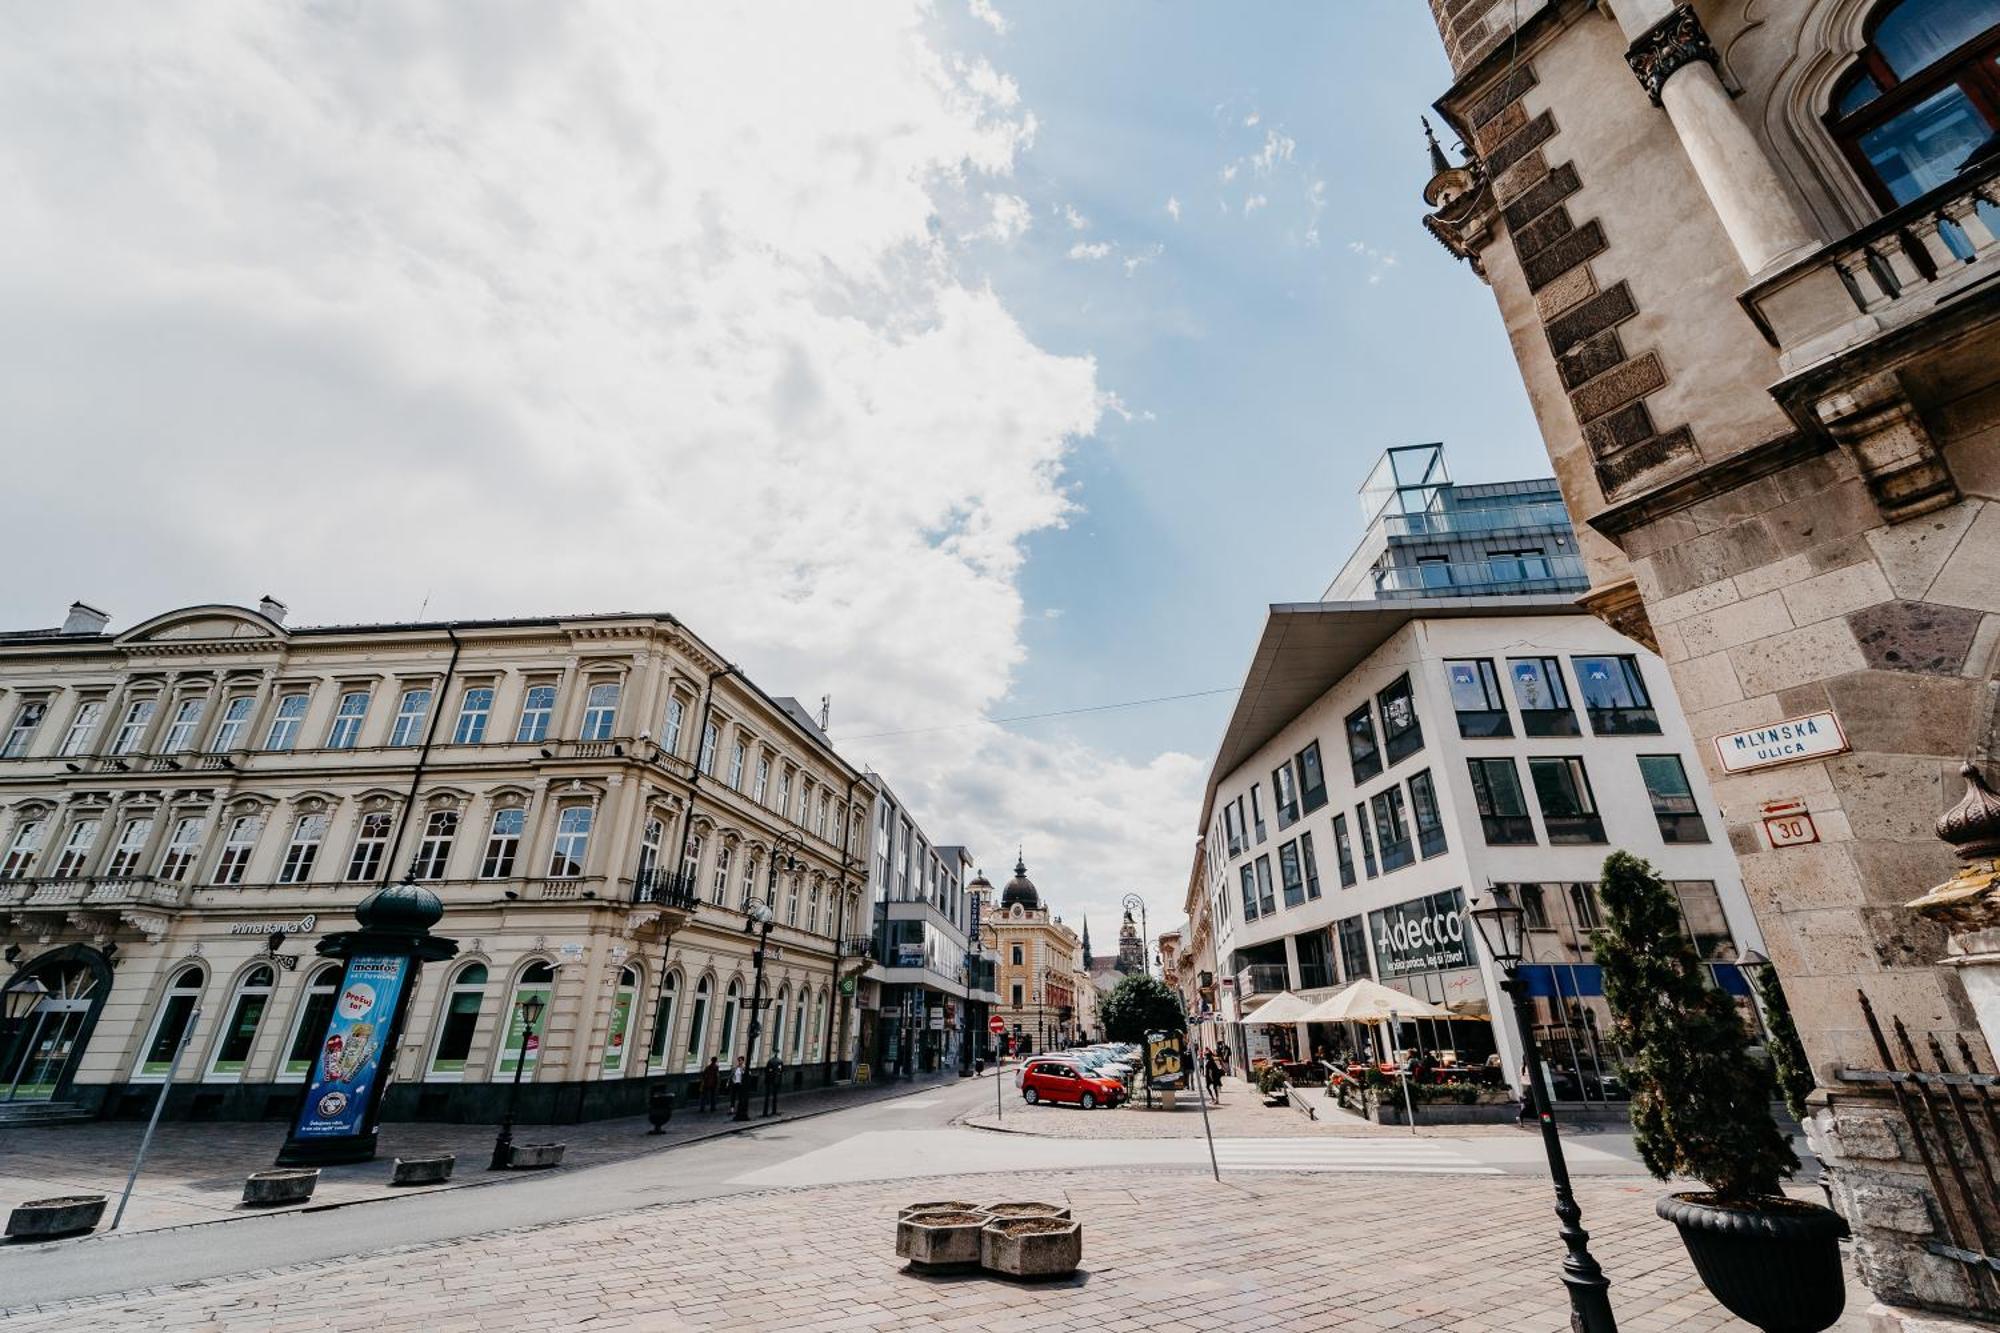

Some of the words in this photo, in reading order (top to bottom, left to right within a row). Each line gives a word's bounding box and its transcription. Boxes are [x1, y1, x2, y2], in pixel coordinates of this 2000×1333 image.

[1758, 743, 1805, 759] ULICA
[1778, 821, 1803, 839] 30
[231, 922, 263, 934] Prima
[1379, 911, 1463, 953] Adecco
[353, 962, 398, 973] mentos
